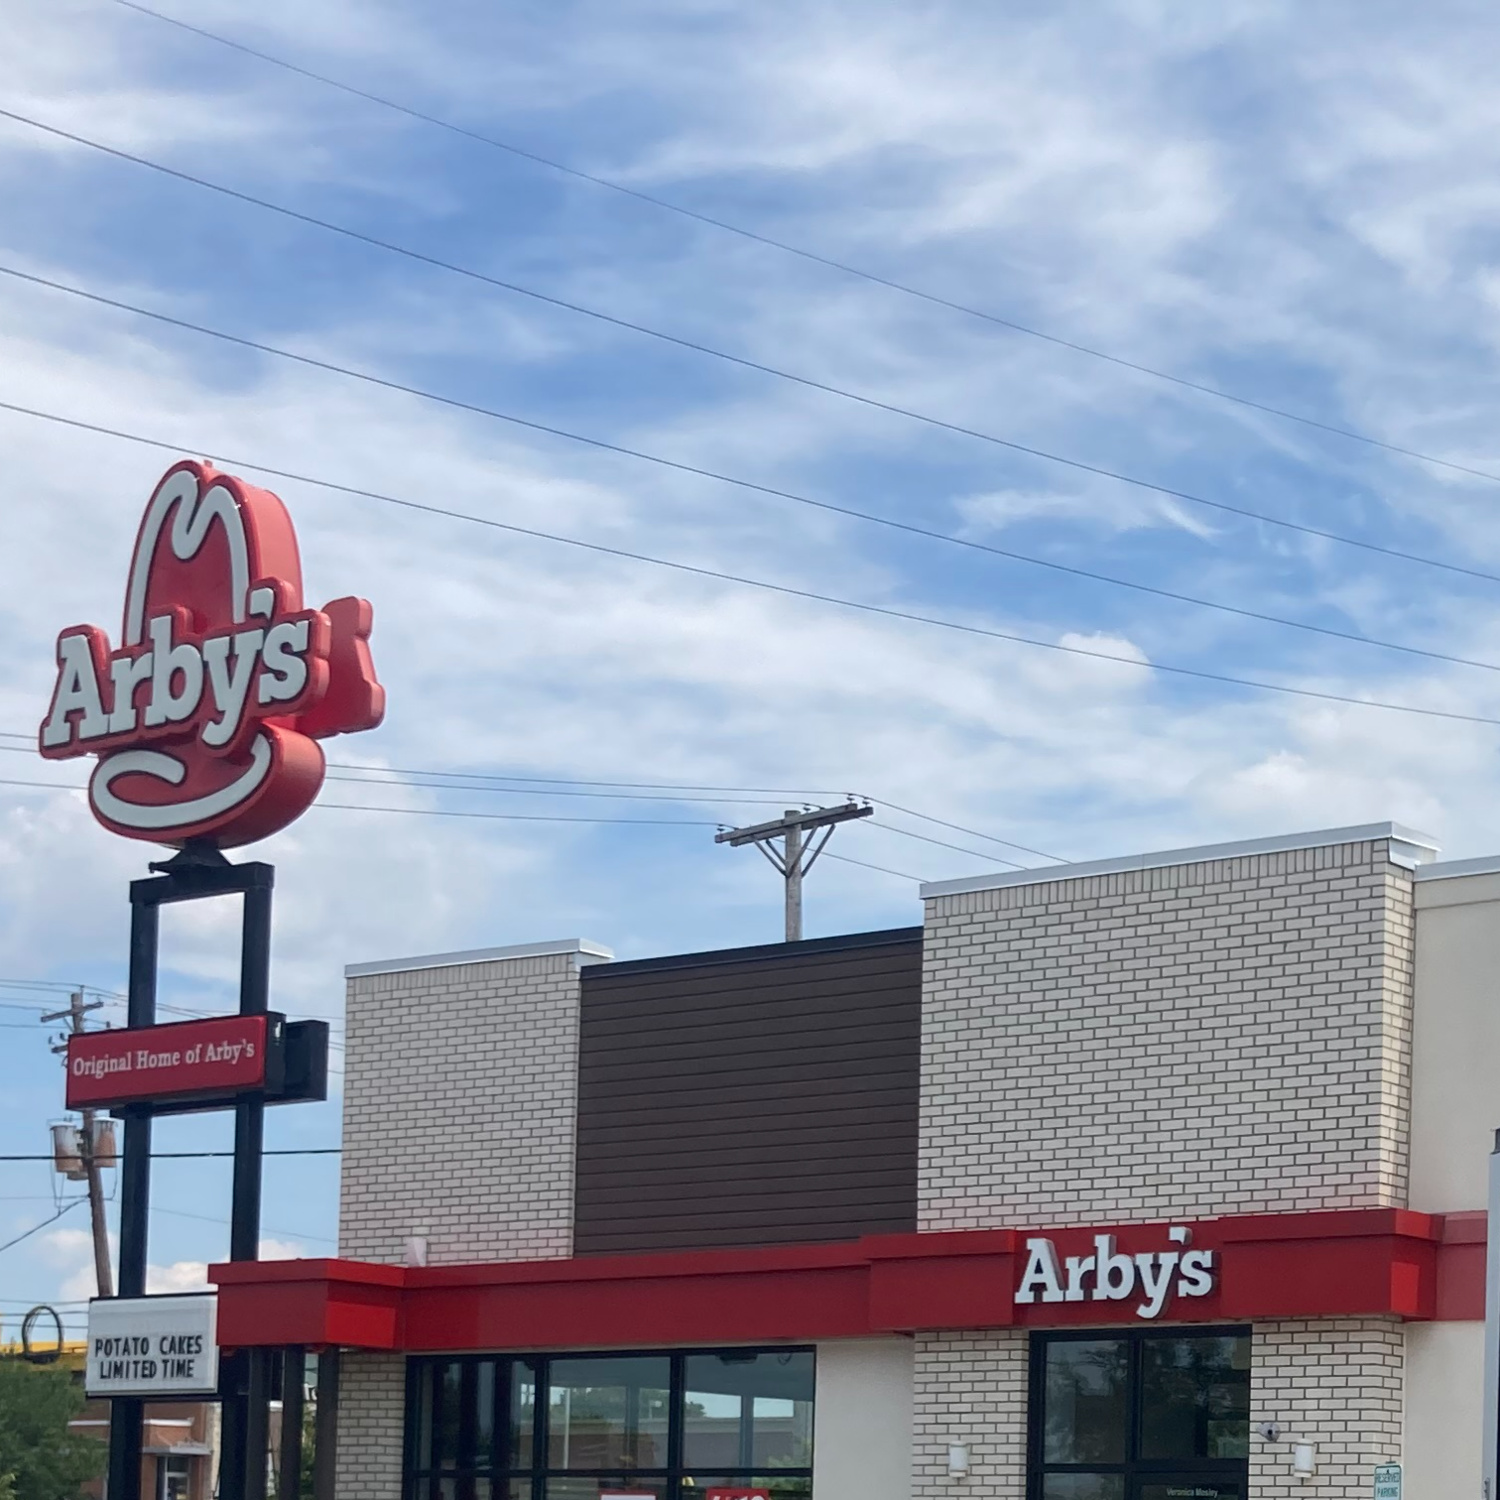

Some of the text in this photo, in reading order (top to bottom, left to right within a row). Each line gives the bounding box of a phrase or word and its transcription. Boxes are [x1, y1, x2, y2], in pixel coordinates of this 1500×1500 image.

[42, 587, 312, 747] Arby's
[73, 1039, 255, 1079] Original Home of Arby's
[1014, 1226, 1214, 1319] Arby's
[95, 1335, 203, 1358] POTATO CAKES
[100, 1359, 195, 1379] LIMITED TIME
